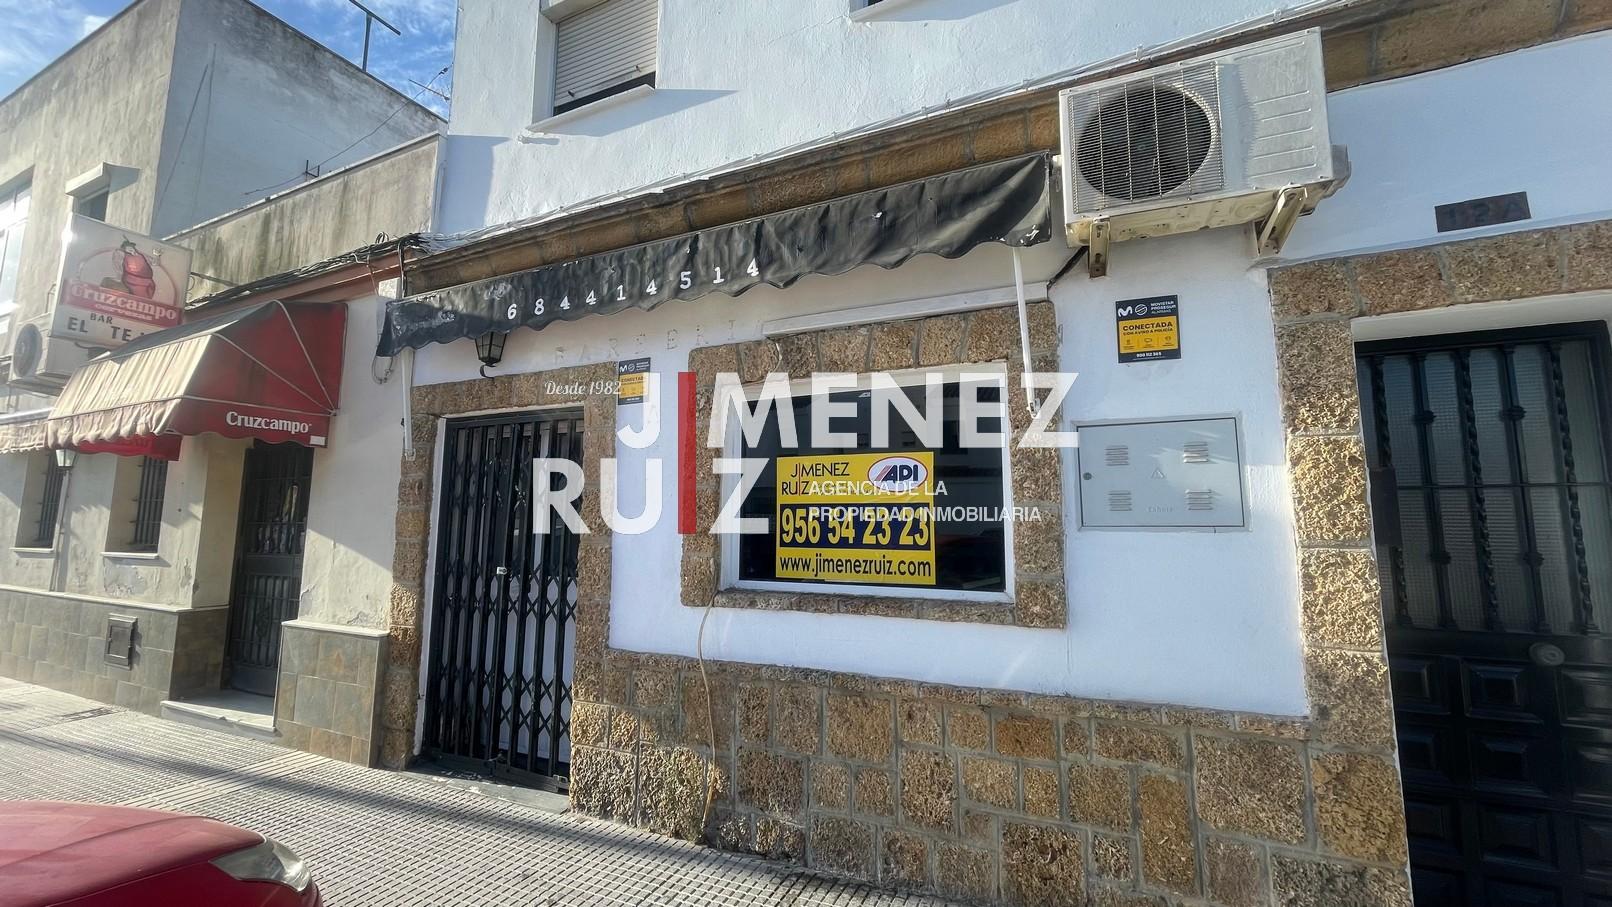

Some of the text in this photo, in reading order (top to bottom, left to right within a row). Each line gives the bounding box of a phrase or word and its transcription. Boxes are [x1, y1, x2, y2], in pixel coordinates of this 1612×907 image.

[70, 283, 178, 321] Cruzcampo
[67, 316, 88, 334] EL
[90, 312, 113, 325] BAR
[1122, 321, 1173, 332] CONECTADA
[225, 411, 309, 435] Cruzcampo
[791, 463, 850, 478] JIMENEZ
[781, 480, 810, 497] RUIZ
[781, 507, 930, 547] 956 54 23 23
[779, 552, 932, 578] www.jimenezruiz.com
